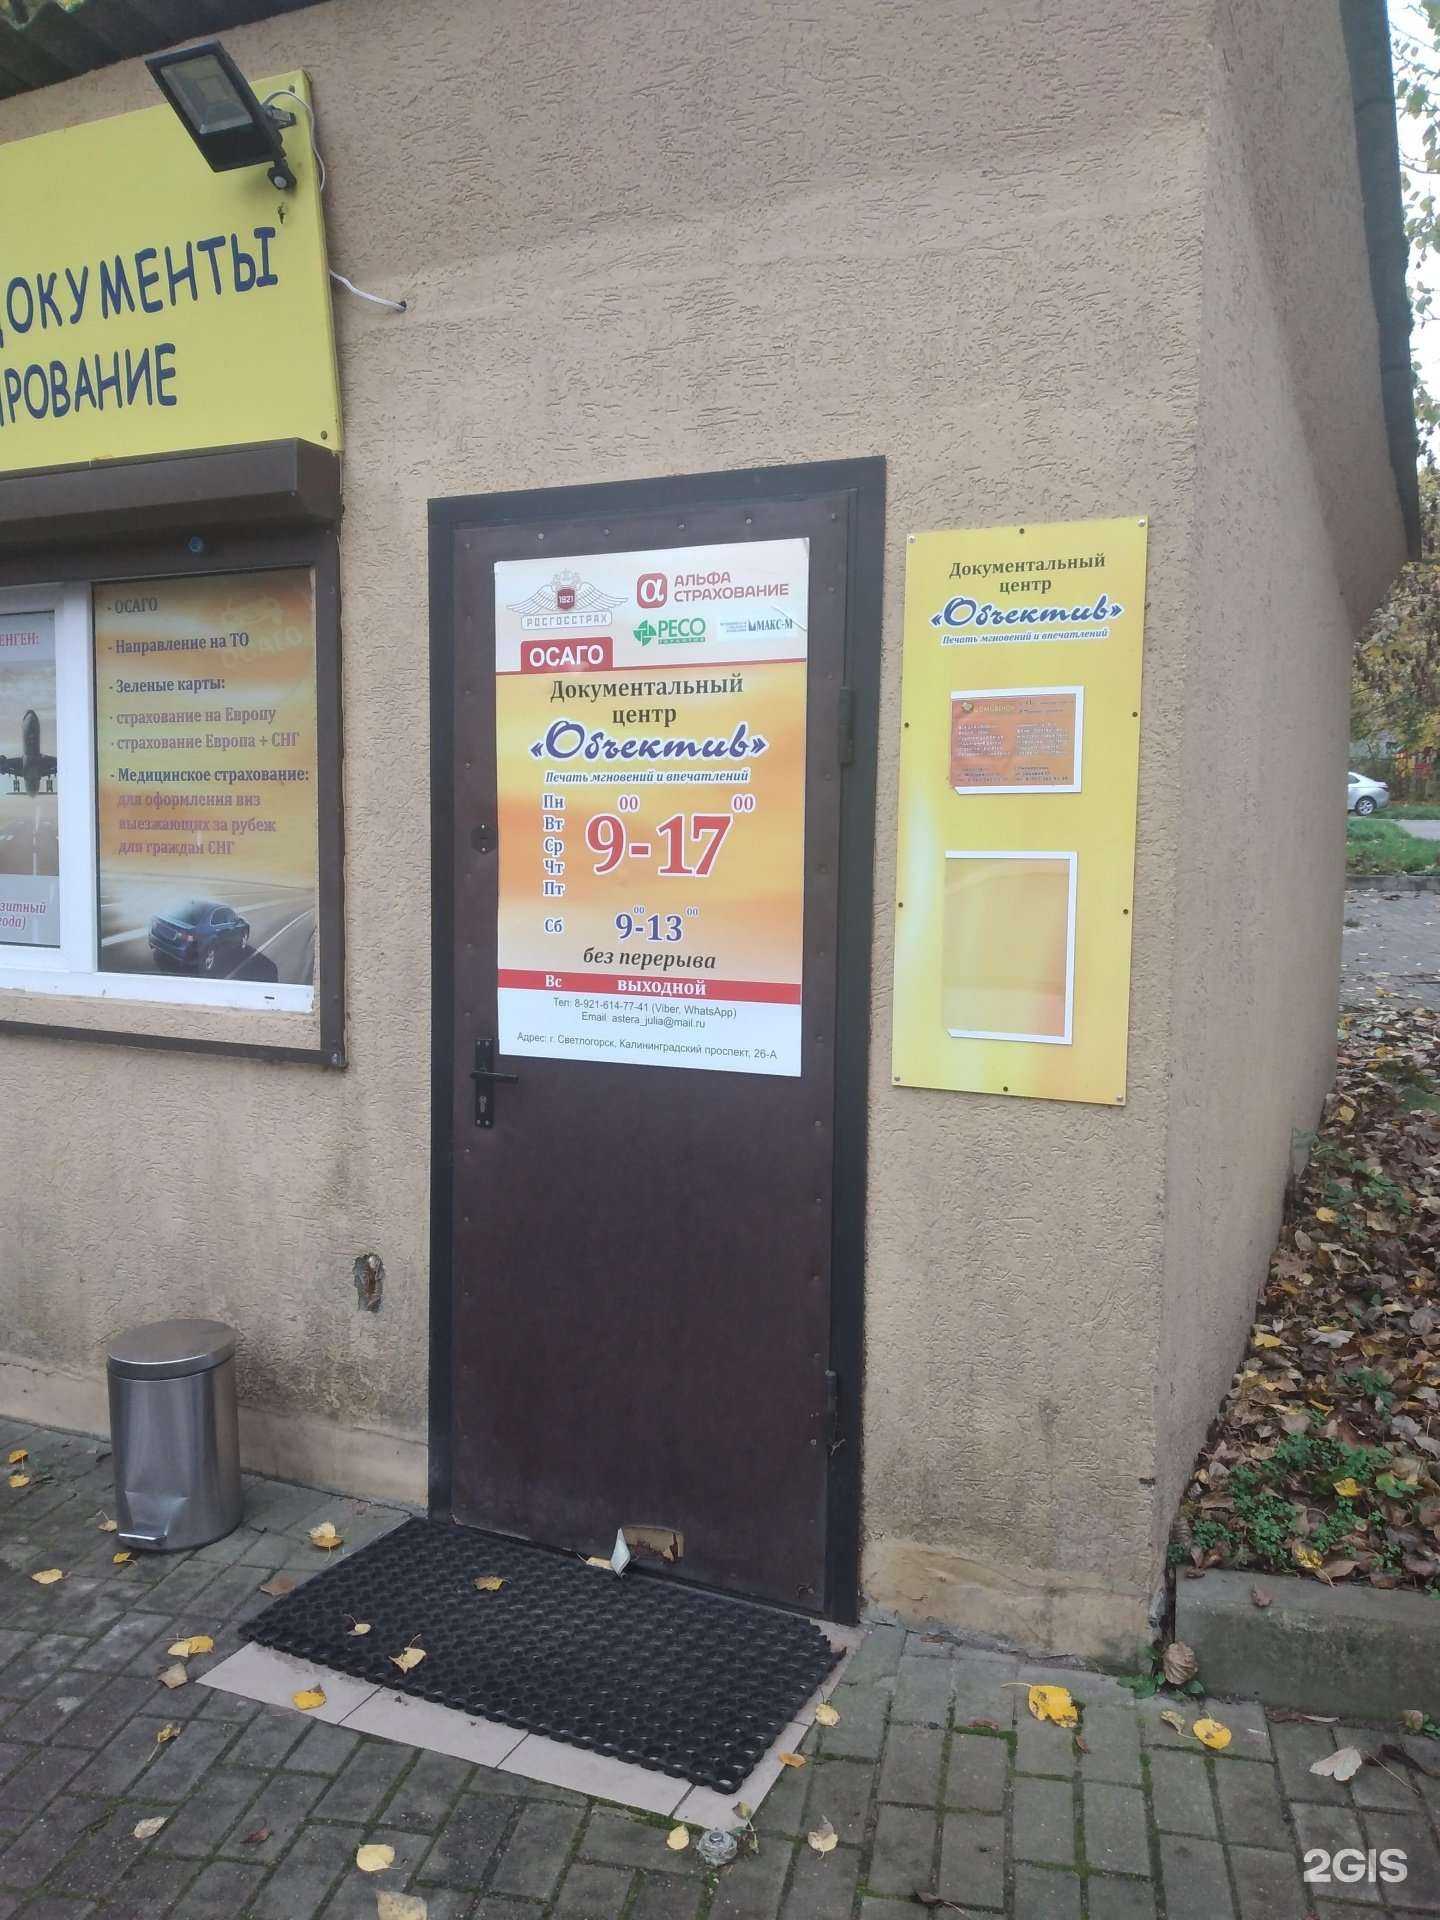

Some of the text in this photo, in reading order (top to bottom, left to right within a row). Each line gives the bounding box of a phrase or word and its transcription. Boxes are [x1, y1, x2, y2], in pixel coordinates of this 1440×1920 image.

[0, 227, 278, 348] ОКУМЕНТЫ
[0, 343, 177, 427] РОВАНИЕ
[949, 553, 1105, 579] Документальный
[674, 572, 731, 587] АЛЬФА
[999, 580, 1051, 594] центр
[674, 584, 789, 602] СТРАХОВАНИЕ
[114, 598, 158, 614] ОСАГО
[931, 595, 1122, 627] «Объектив»
[526, 614, 608, 628] РОСГОССТРАХ
[658, 618, 706, 638] РЕСО
[116, 632, 249, 656] Направление на ТО
[943, 629, 1108, 644] Печать мгновений и впечатлений
[529, 645, 604, 667] ОСАГО
[116, 678, 224, 694] Зеленые карты:
[550, 674, 743, 702] Документальный
[117, 708, 276, 727] страхование на Европу
[612, 706, 677, 727] центр
[117, 736, 202, 752] страхование
[206, 733, 256, 750] Европа
[272, 732, 299, 747] СНГ
[531, 719, 766, 758] «Объектив»
[118, 767, 309, 785] Медицинское страхование:
[546, 770, 748, 783] Печать мгновений и впечатлений
[145, 792, 232, 808] оформления
[236, 797, 260, 806] виз
[544, 795, 563, 809] Пн
[620, 796, 638, 810] 00
[733, 796, 754, 810] 00
[119, 818, 276, 834] выезжающих за рубеж
[545, 817, 563, 830] Вт
[146, 845, 203, 856] граждан
[208, 840, 235, 855] СНГ
[545, 838, 563, 855] Ср
[545, 861, 563, 874] Чт
[544, 882, 563, 895] Пт
[545, 919, 562, 932] Сб
[584, 948, 716, 971] без перерыва
[545, 975, 706, 996] Вс выходной
[574, 999, 649, 1012] 8-921-614-77-41
[684, 1005, 737, 1018] WhatsApp)
[612, 1014, 706, 1028] astera_julia@mail.ru
[619, 1040, 702, 1054] Калининградский
[704, 1047, 751, 1059] проспект,
[753, 1049, 778, 1059] 26-А
